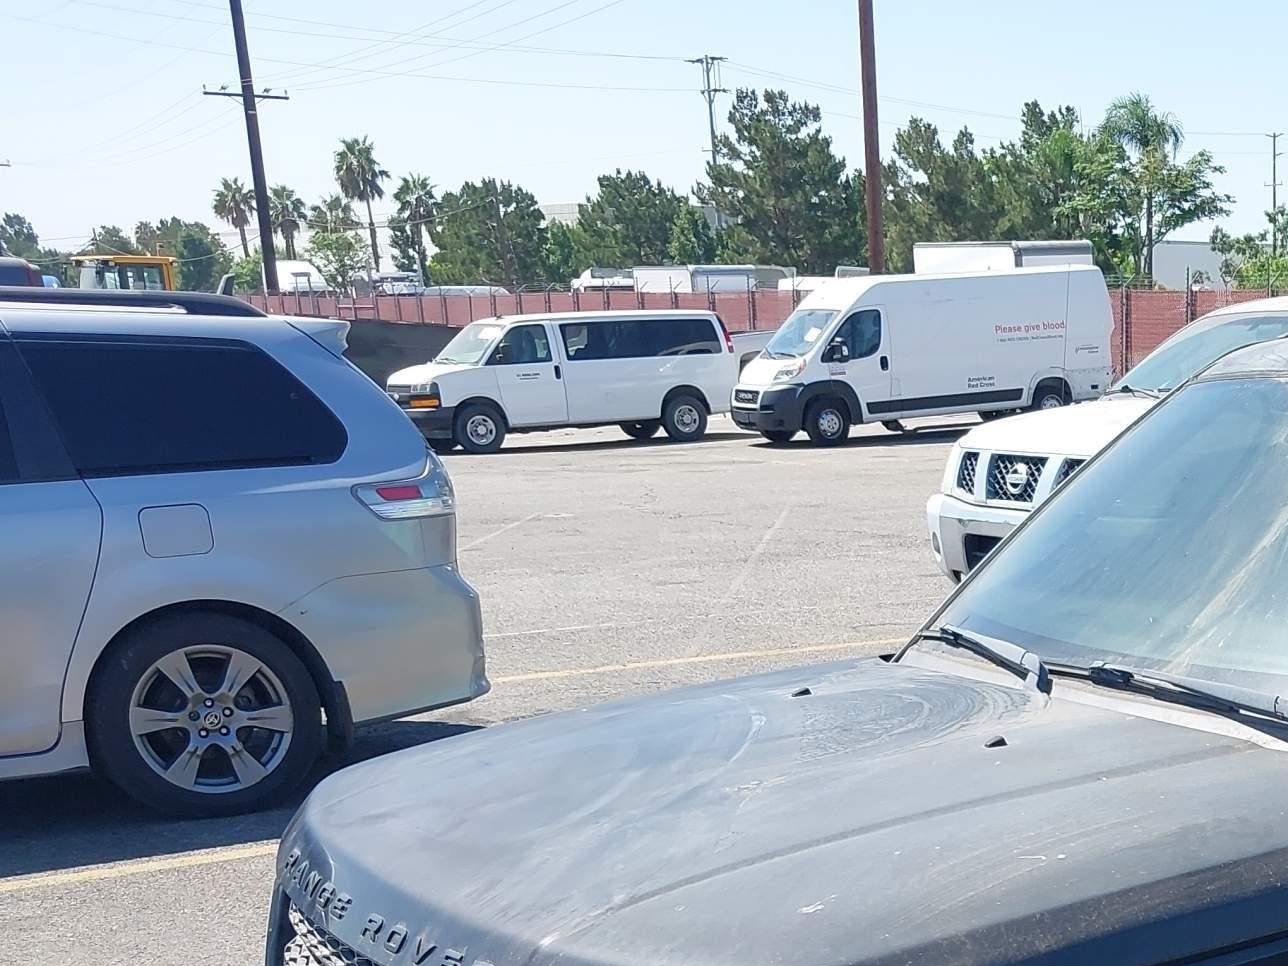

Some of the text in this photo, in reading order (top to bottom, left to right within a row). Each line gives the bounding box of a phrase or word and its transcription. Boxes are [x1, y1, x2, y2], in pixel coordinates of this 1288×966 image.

[995, 320, 1065, 333] Please give blood
[285, 848, 352, 920] RANGE
